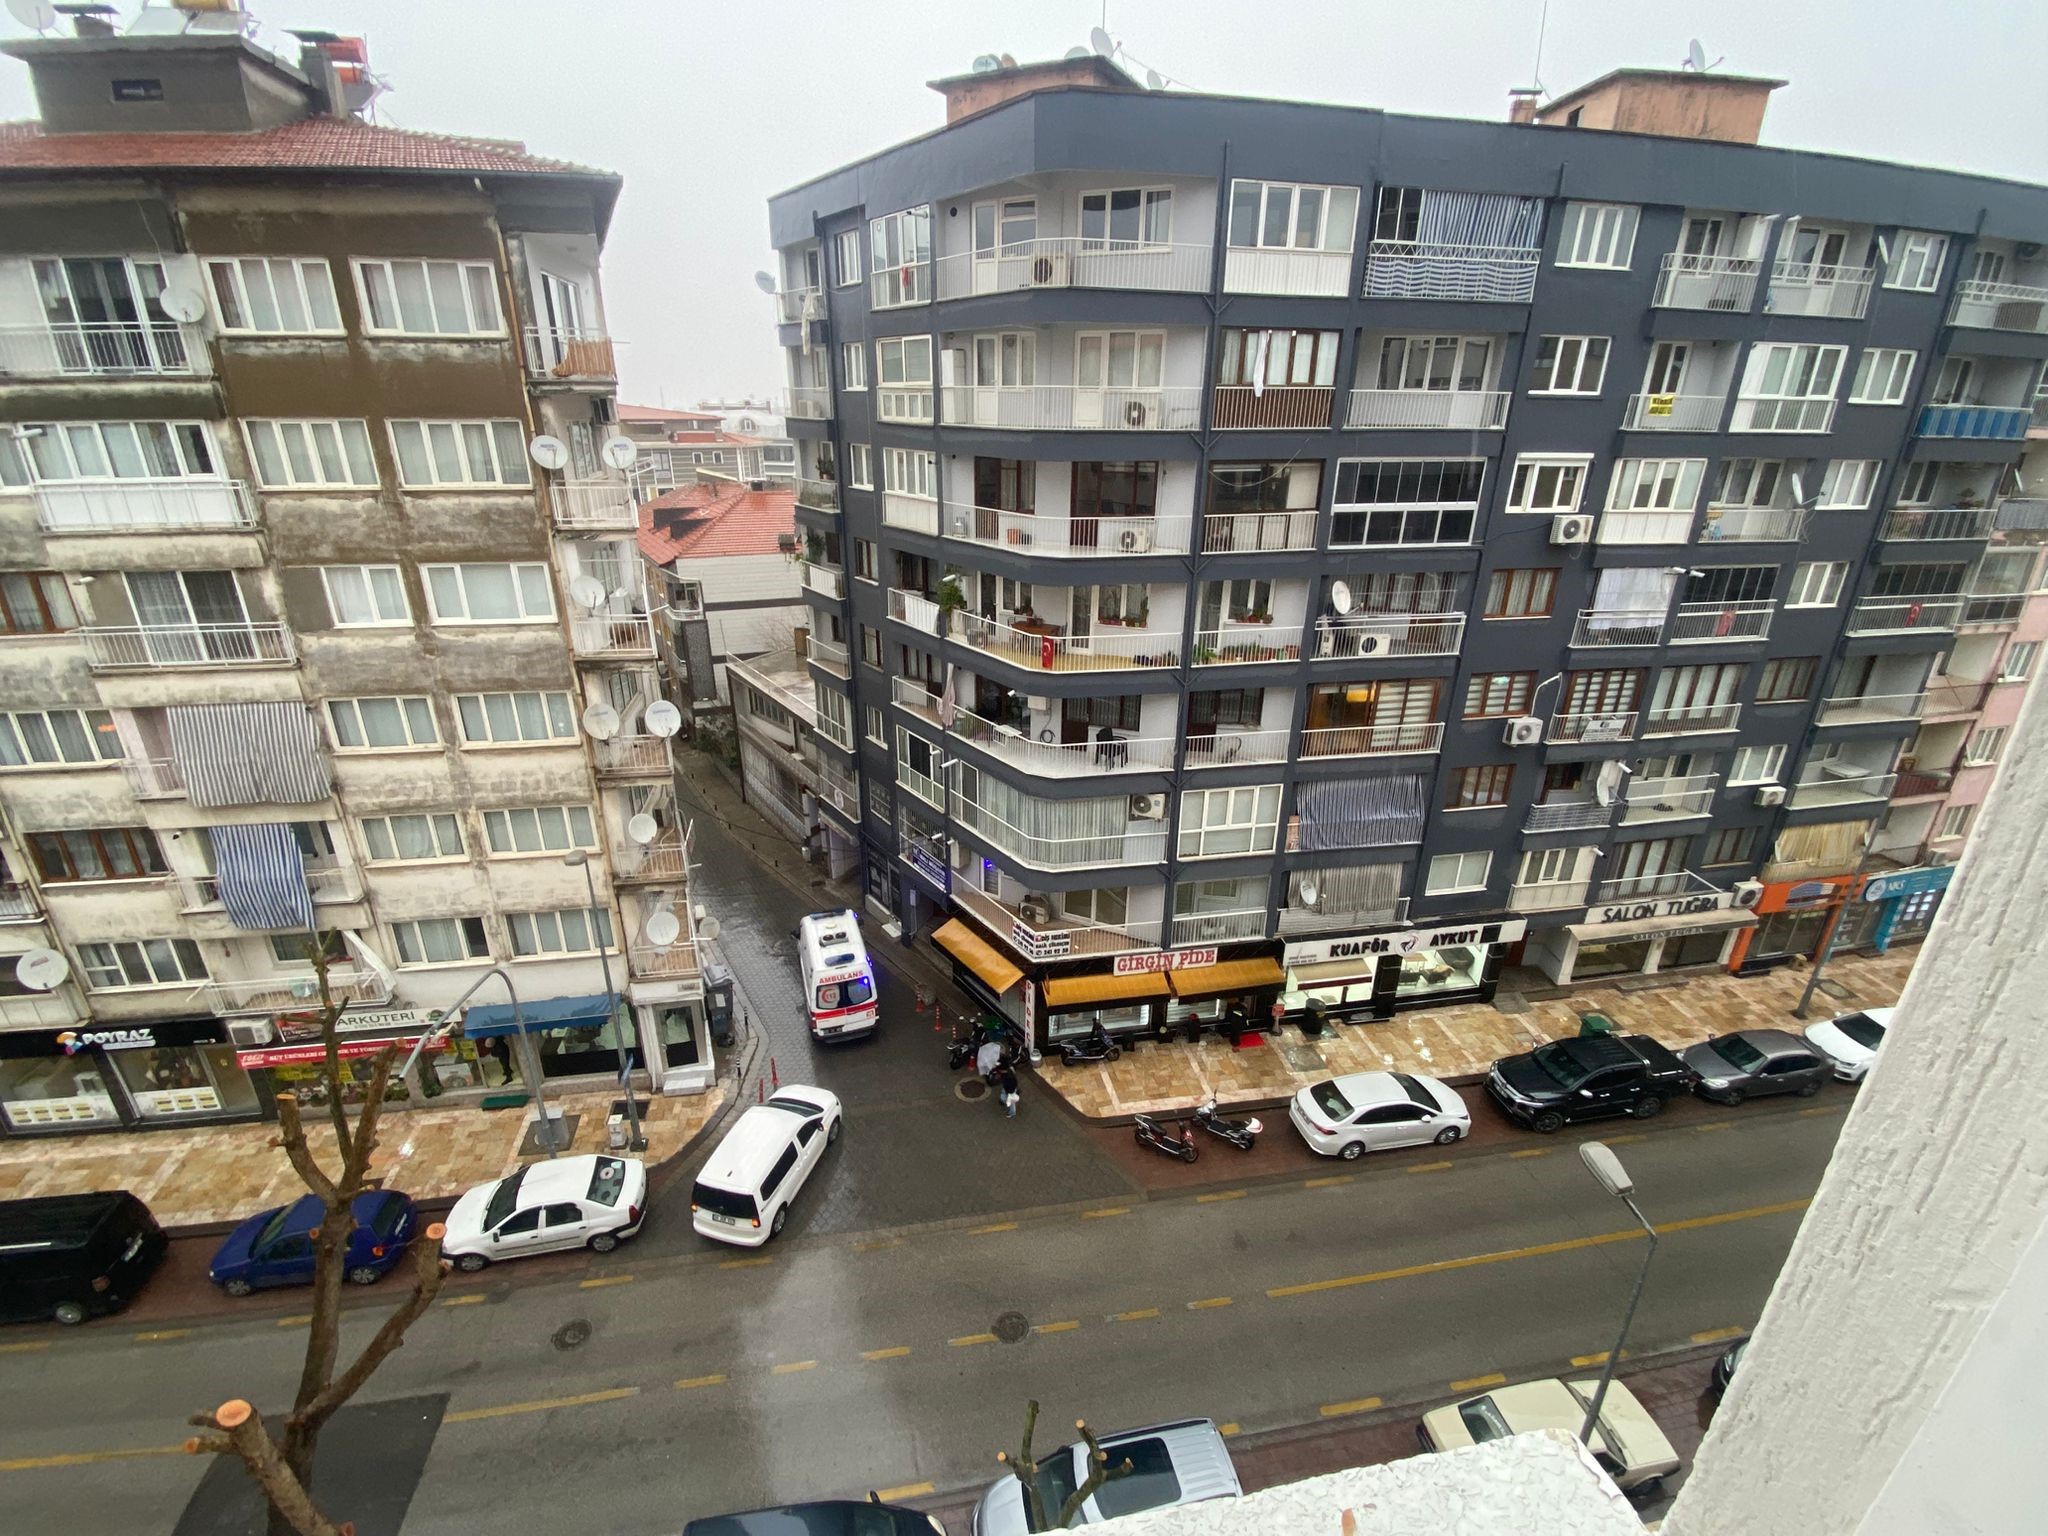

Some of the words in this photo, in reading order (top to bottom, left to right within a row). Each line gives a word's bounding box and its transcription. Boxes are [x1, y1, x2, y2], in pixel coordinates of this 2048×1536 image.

[1601, 903, 1659, 923] SALON
[1329, 937, 1391, 958] KUAFÖR
[1429, 929, 1479, 947] AYKUT
[1632, 931, 1666, 941] SALON
[1117, 951, 1176, 972] GİRGİN
[1178, 948, 1215, 967] PİDE
[819, 970, 864, 984] AMBULANS
[336, 1010, 415, 1026] ARKÜTERİ
[82, 1028, 154, 1045] POYRAZ
